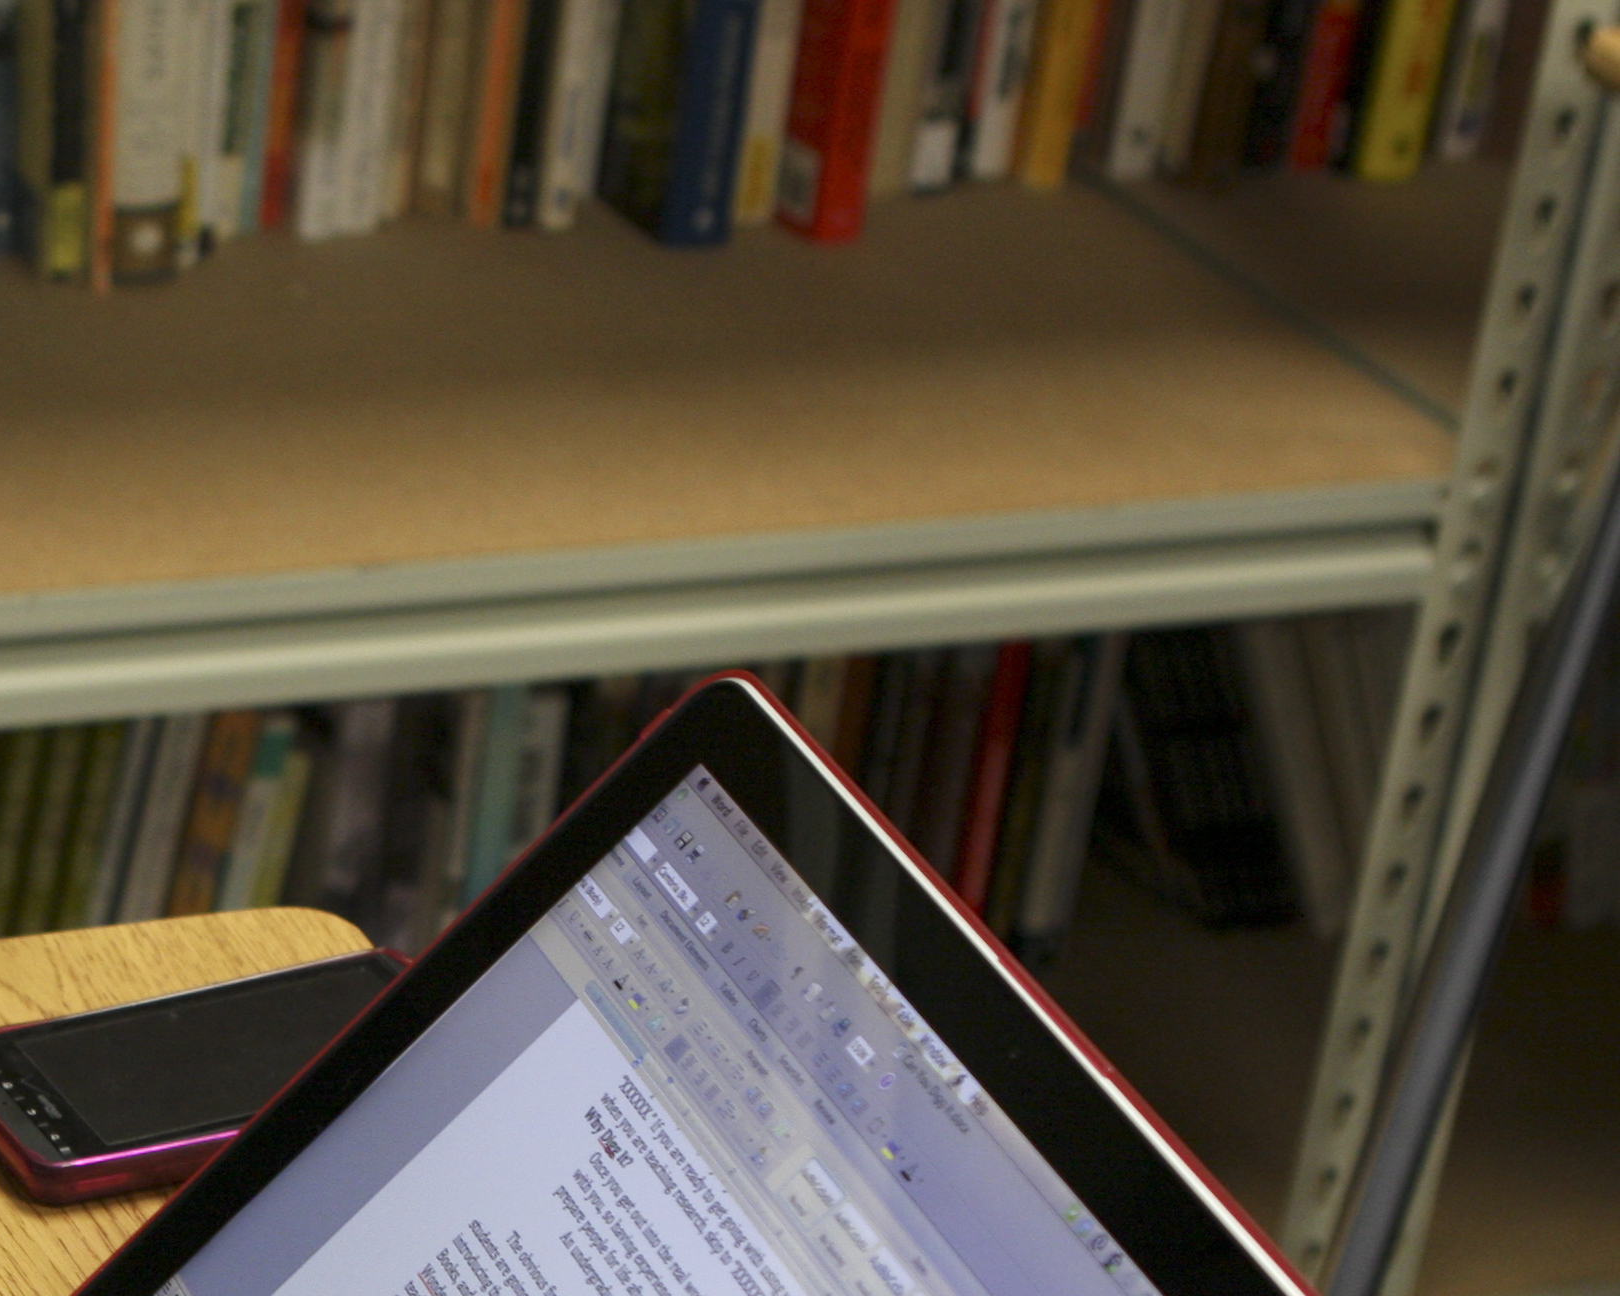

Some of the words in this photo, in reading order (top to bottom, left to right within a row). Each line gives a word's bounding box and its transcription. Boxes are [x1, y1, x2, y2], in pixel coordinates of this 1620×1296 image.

[584, 1106, 604, 1134] Why
[598, 1129, 621, 1158] Digg
[616, 1150, 633, 1168] It?
[649, 1118, 664, 1133] If
[652, 1129, 673, 1150] you
[669, 1147, 685, 1165] are
[600, 1093, 622, 1120] when
[615, 1117, 635, 1138] you
[631, 1135, 647, 1153] are
[644, 1150, 676, 1194] teaching
[672, 1189, 707, 1234] research,
[703, 1231, 723, 1254] skip
[719, 1250, 732, 1265] to
[681, 1163, 706, 1192] ready
[701, 1188, 714, 1203] to
[707, 1201, 727, 1219] get
[589, 1151, 609, 1179] Once
[601, 1175, 622, 1197] you
[615, 1195, 635, 1212] get
[629, 1210, 647, 1229] out
[642, 1224, 660, 1247] into
[668, 1262, 690, 1284] real
[719, 1216, 747, 1248] going
[552, 1185, 585, 1223] prepare
[578, 1221, 608, 1254] people
[603, 1249, 619, 1268] for
[614, 1263, 631, 1285] life
[436, 1248, 459, 1284] Books,
[743, 1242, 764, 1267] with
[759, 1265, 784, 1296] using
